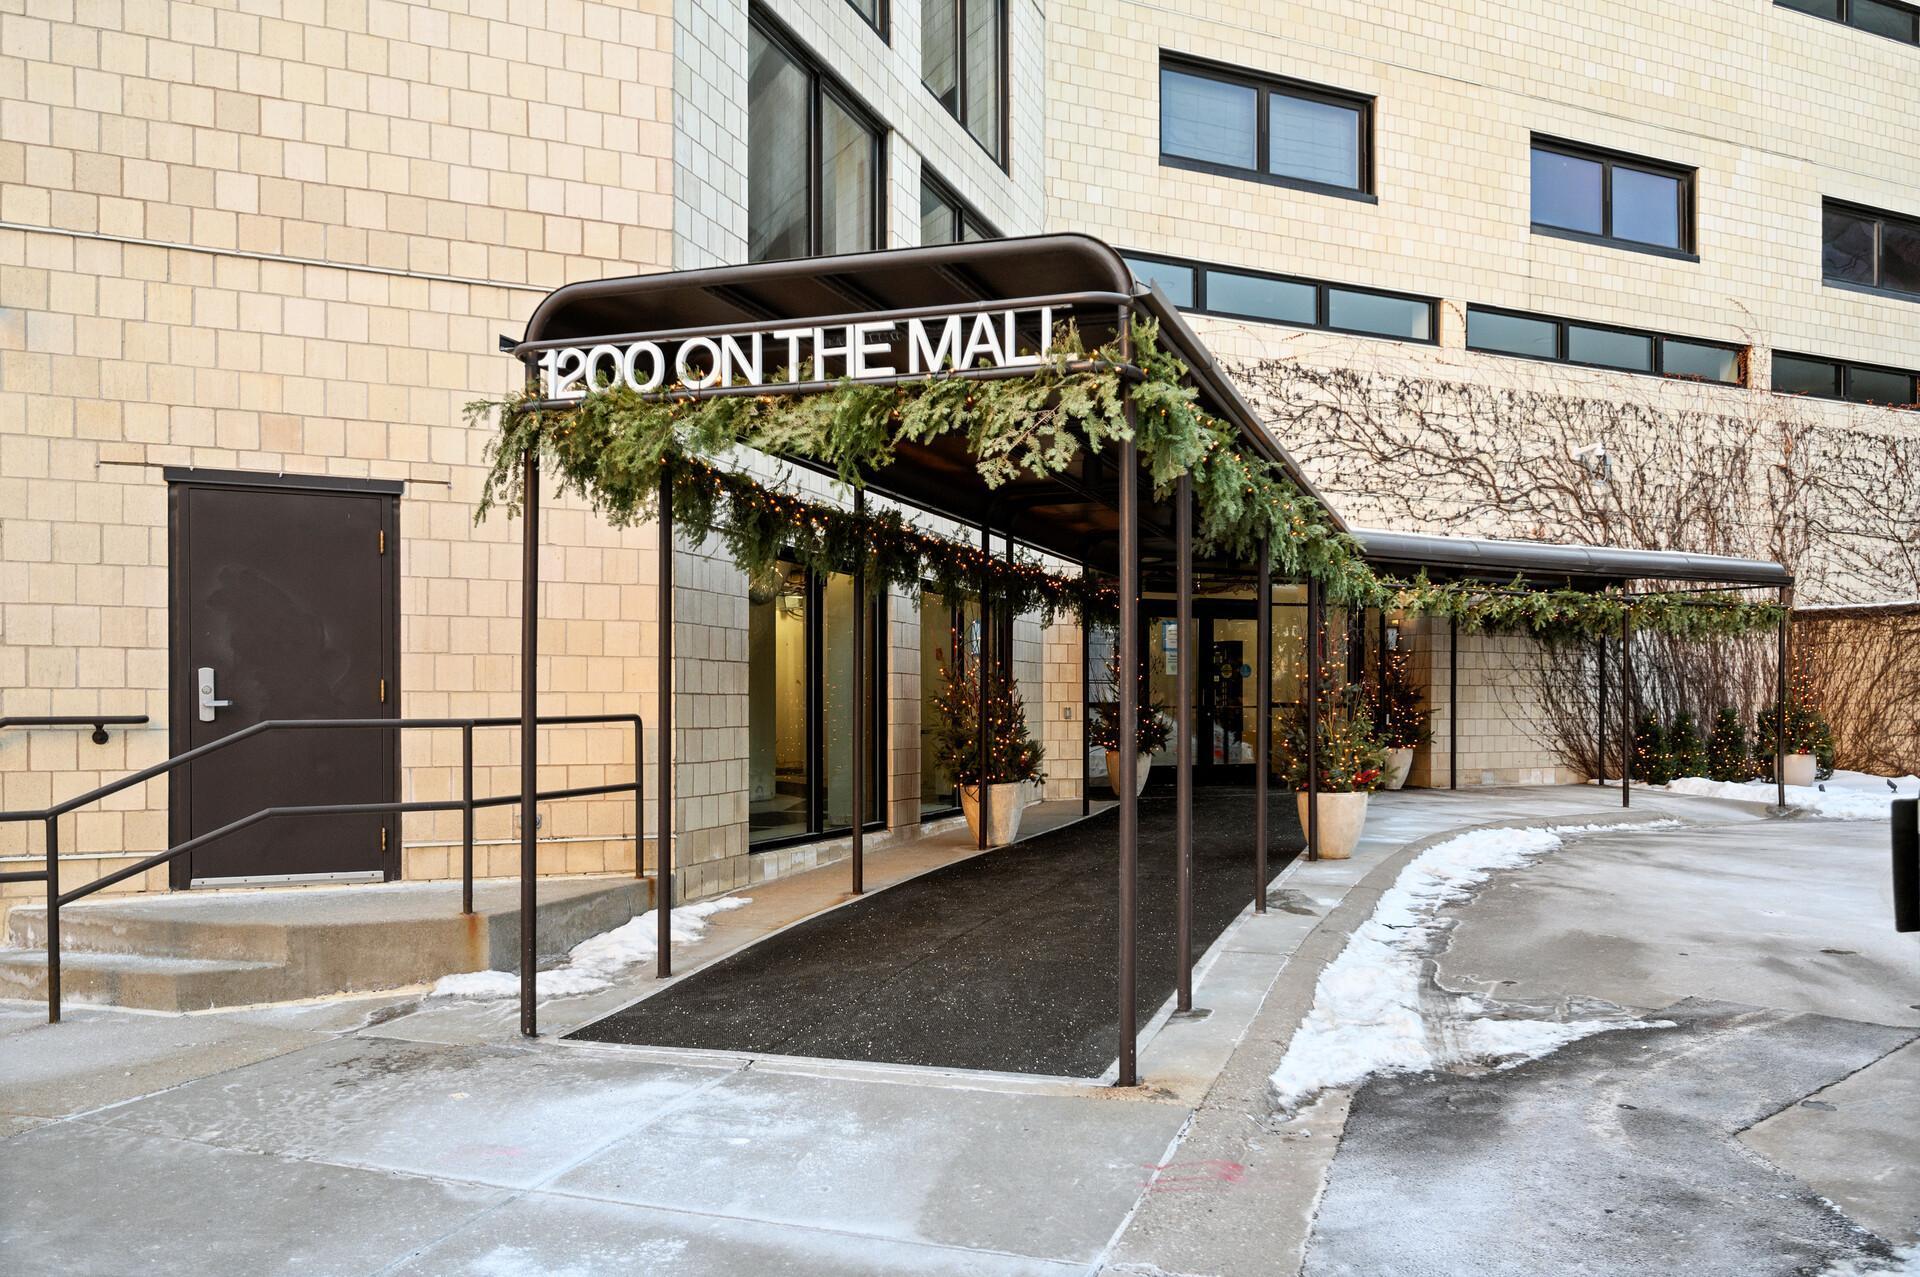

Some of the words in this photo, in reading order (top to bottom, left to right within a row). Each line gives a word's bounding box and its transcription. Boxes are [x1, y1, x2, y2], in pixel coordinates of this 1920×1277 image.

[538, 341, 665, 400] 1200
[676, 331, 763, 390] ON
[773, 320, 896, 384] THE
[908, 306, 1079, 374] MALL
